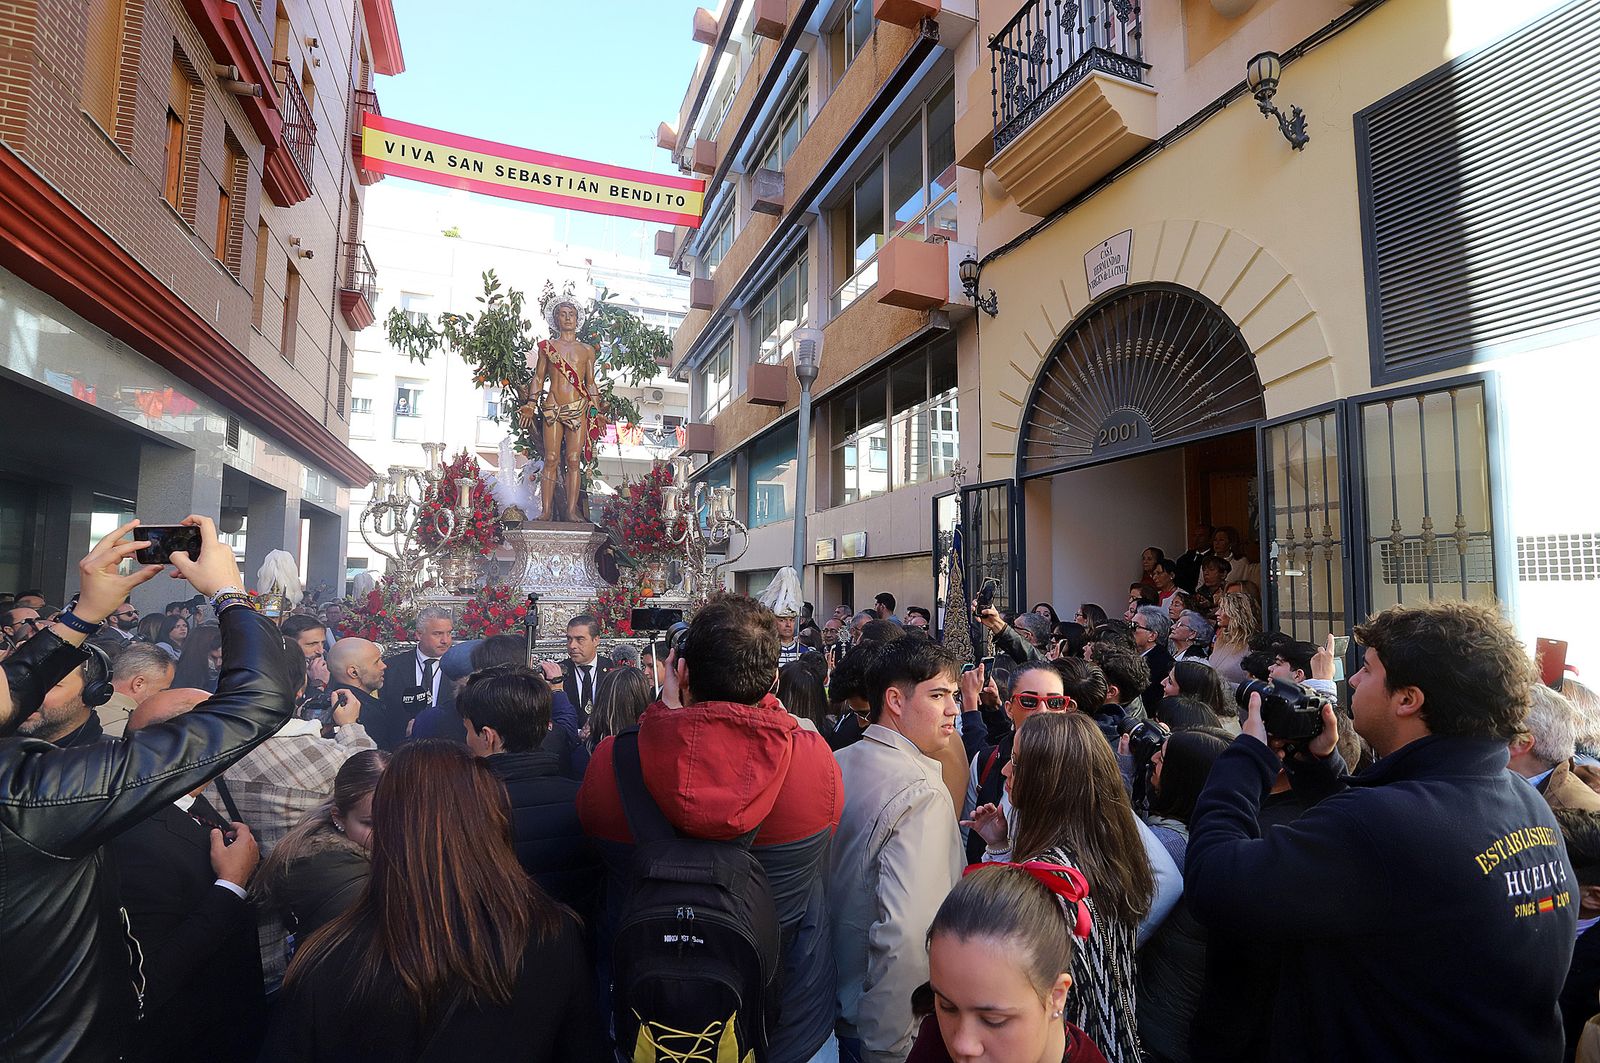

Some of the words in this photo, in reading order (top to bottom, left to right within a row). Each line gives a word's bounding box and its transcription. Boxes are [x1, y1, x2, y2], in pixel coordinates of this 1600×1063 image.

[384, 140, 435, 164] VIVA
[447, 154, 484, 173] SAN
[494, 164, 599, 194] SEBASTIÁN
[609, 184, 686, 207] BENDITO
[1093, 254, 1121, 276] HERMANDAD
[1100, 246, 1113, 260] CASA
[1098, 420, 1139, 447] 2001
[1504, 860, 1567, 897] HUELVA
[1514, 901, 1537, 918] SINCE
